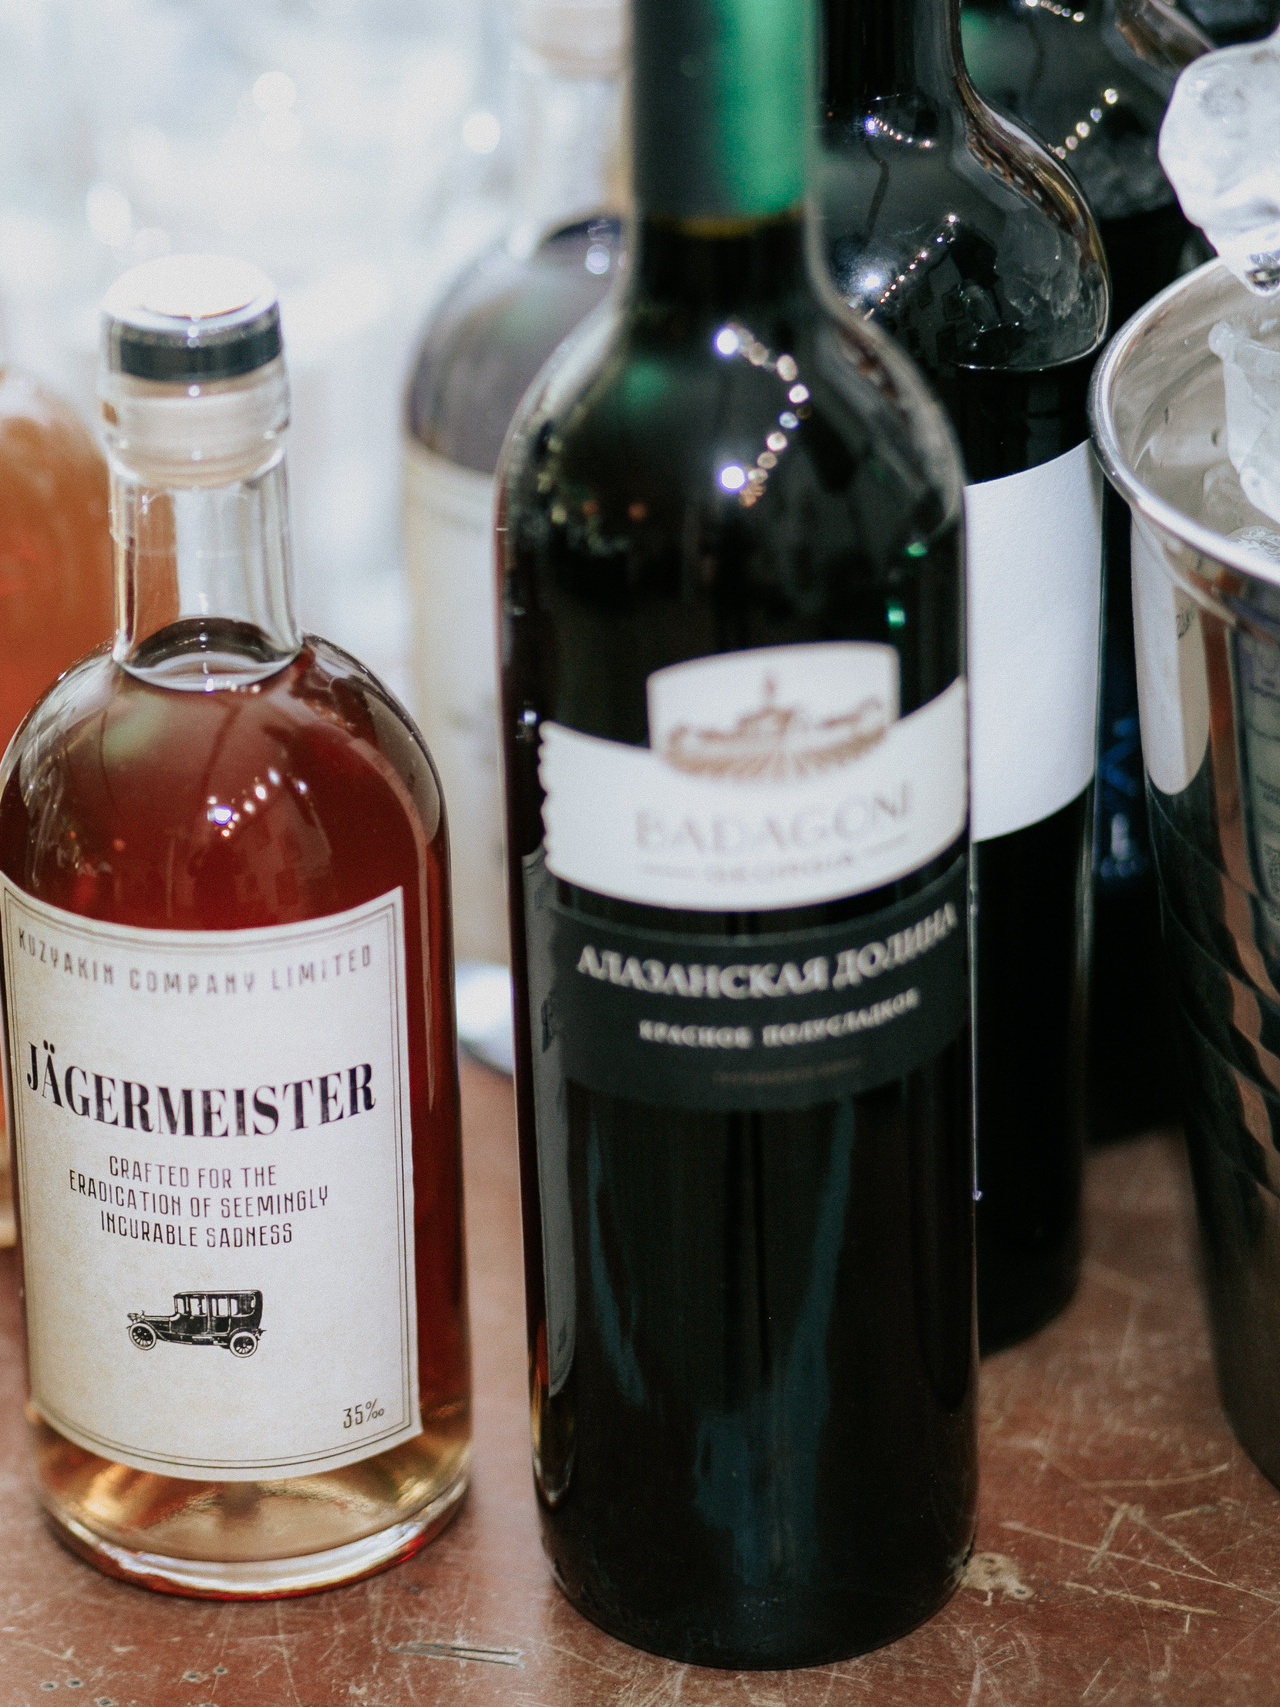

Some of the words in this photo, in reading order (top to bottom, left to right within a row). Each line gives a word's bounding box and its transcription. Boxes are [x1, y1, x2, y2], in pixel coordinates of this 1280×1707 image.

[17, 927, 115, 986] KUZYAKIN
[128, 967, 257, 997] COMPANY
[270, 943, 373, 991] LIMITED
[576, 944, 830, 999] АЛАЗАНСКАЯ
[832, 901, 959, 991] ДОЛИНА
[638, 1018, 754, 1050] КРАСНОЕ
[26, 1039, 377, 1139] JÄGERMEISTER
[68, 1168, 182, 1217] ERADICATION
[189, 1197, 212, 1219] OF
[219, 1184, 330, 1220] SEEMINGLY
[108, 1154, 190, 1189] CRAFTED
[197, 1167, 233, 1190] FOR
[239, 1164, 278, 1189] THE
[99, 1209, 199, 1249] INCURABLE
[205, 1222, 294, 1249] SADNESS
